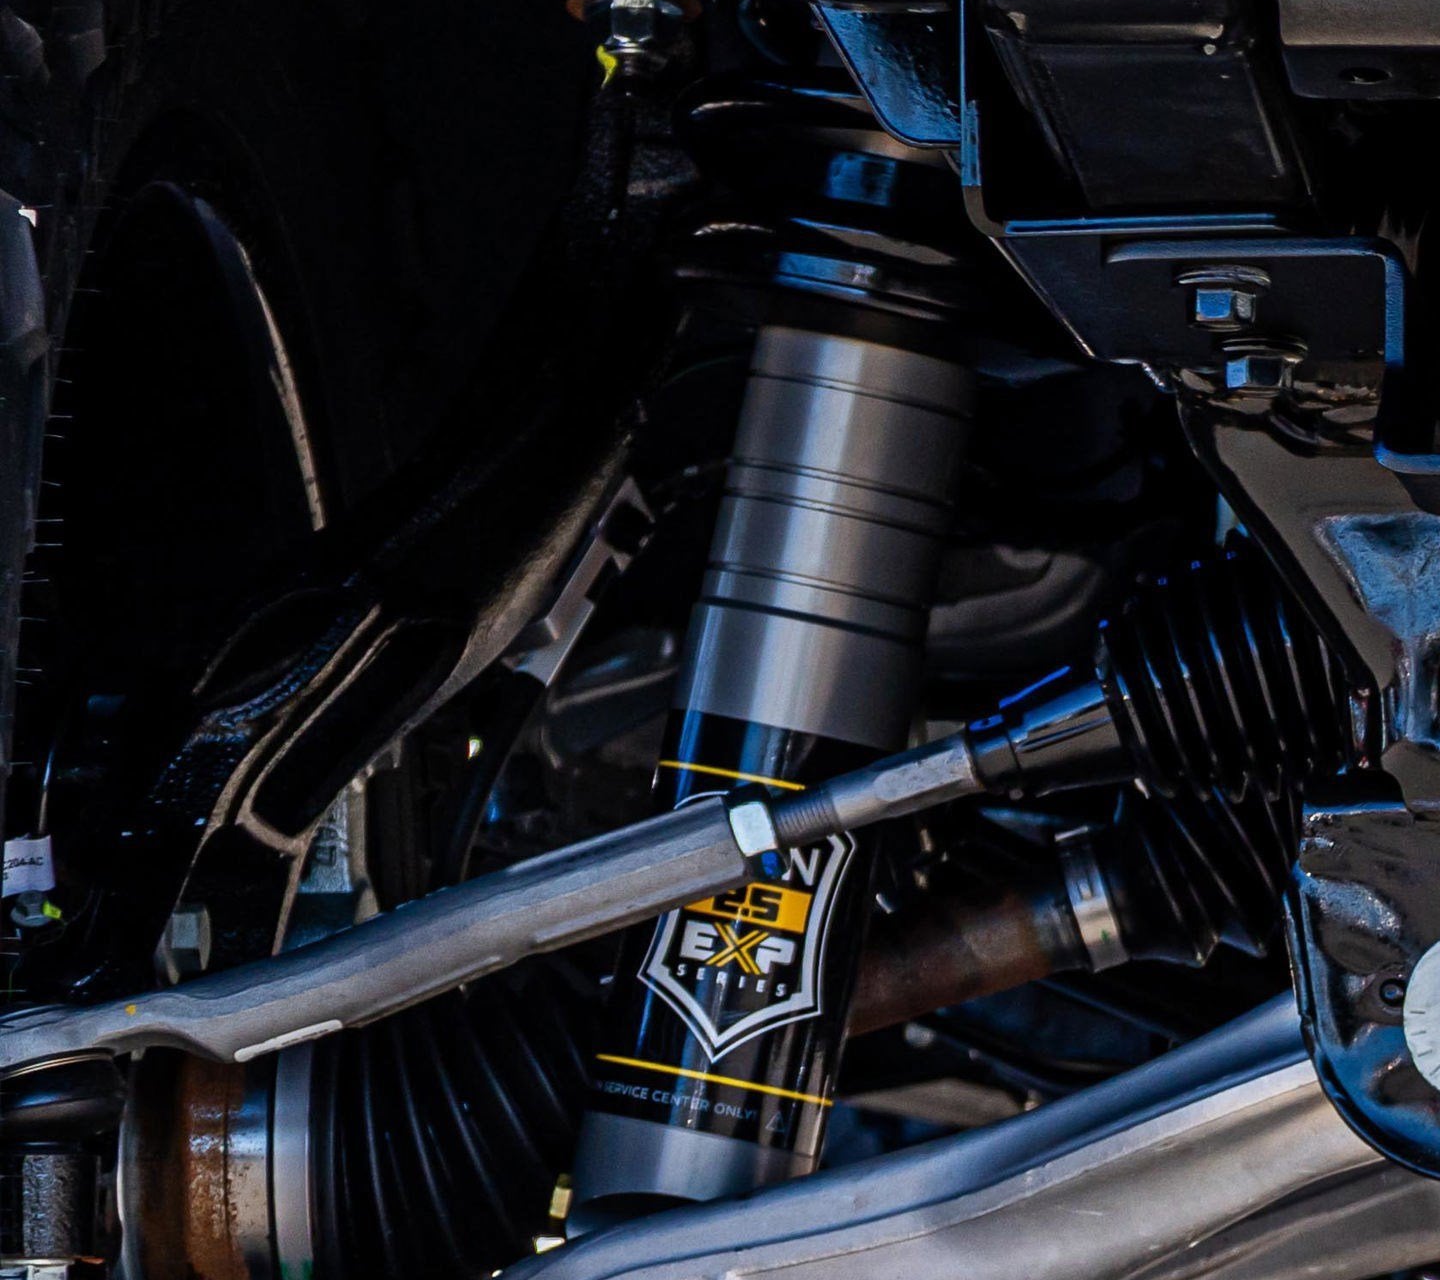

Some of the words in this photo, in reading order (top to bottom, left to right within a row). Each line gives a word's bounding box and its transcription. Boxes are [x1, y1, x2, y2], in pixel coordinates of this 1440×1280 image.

[679, 920, 797, 976] EXP
[676, 963, 788, 997] SERIES
[651, 1089, 711, 1112] CENTER
